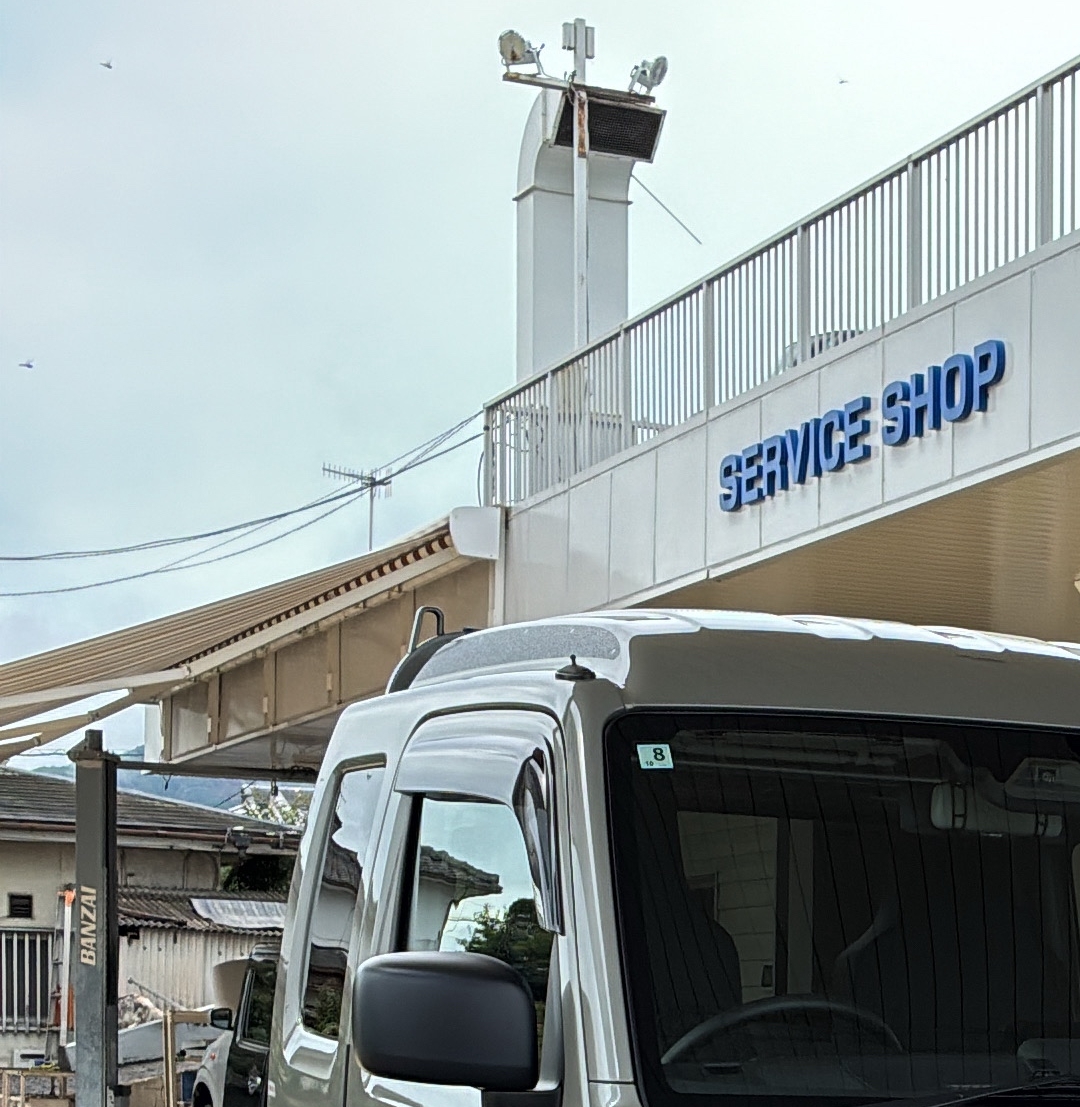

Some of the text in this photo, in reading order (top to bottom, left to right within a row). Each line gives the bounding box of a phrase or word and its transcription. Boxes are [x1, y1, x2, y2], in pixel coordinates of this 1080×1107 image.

[719, 339, 1005, 512] SERVICE SHOP
[652, 747, 665, 761] 8
[80, 885, 97, 966] BANZAI
